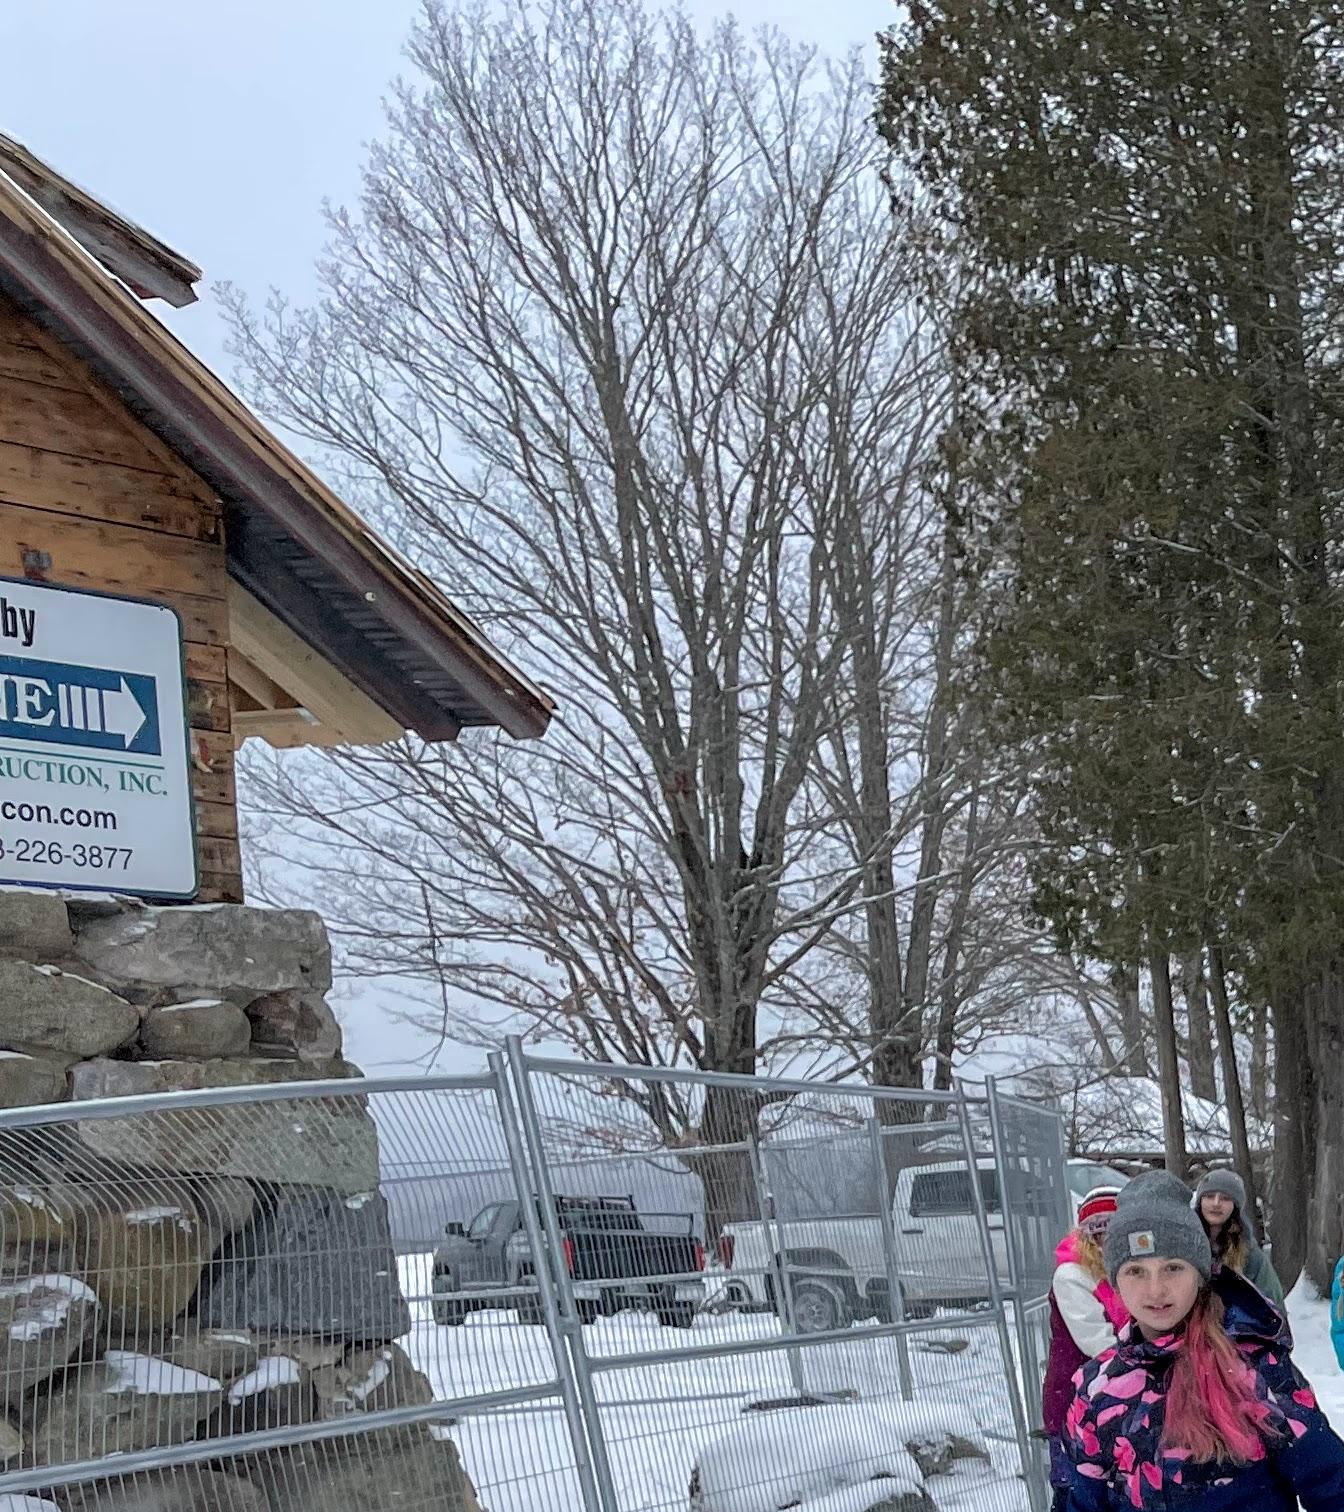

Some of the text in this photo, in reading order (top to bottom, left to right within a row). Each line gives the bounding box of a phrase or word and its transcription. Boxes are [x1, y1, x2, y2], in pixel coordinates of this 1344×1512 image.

[0, 756, 168, 796] UCTION, INC.
[1, 801, 117, 830] con.com
